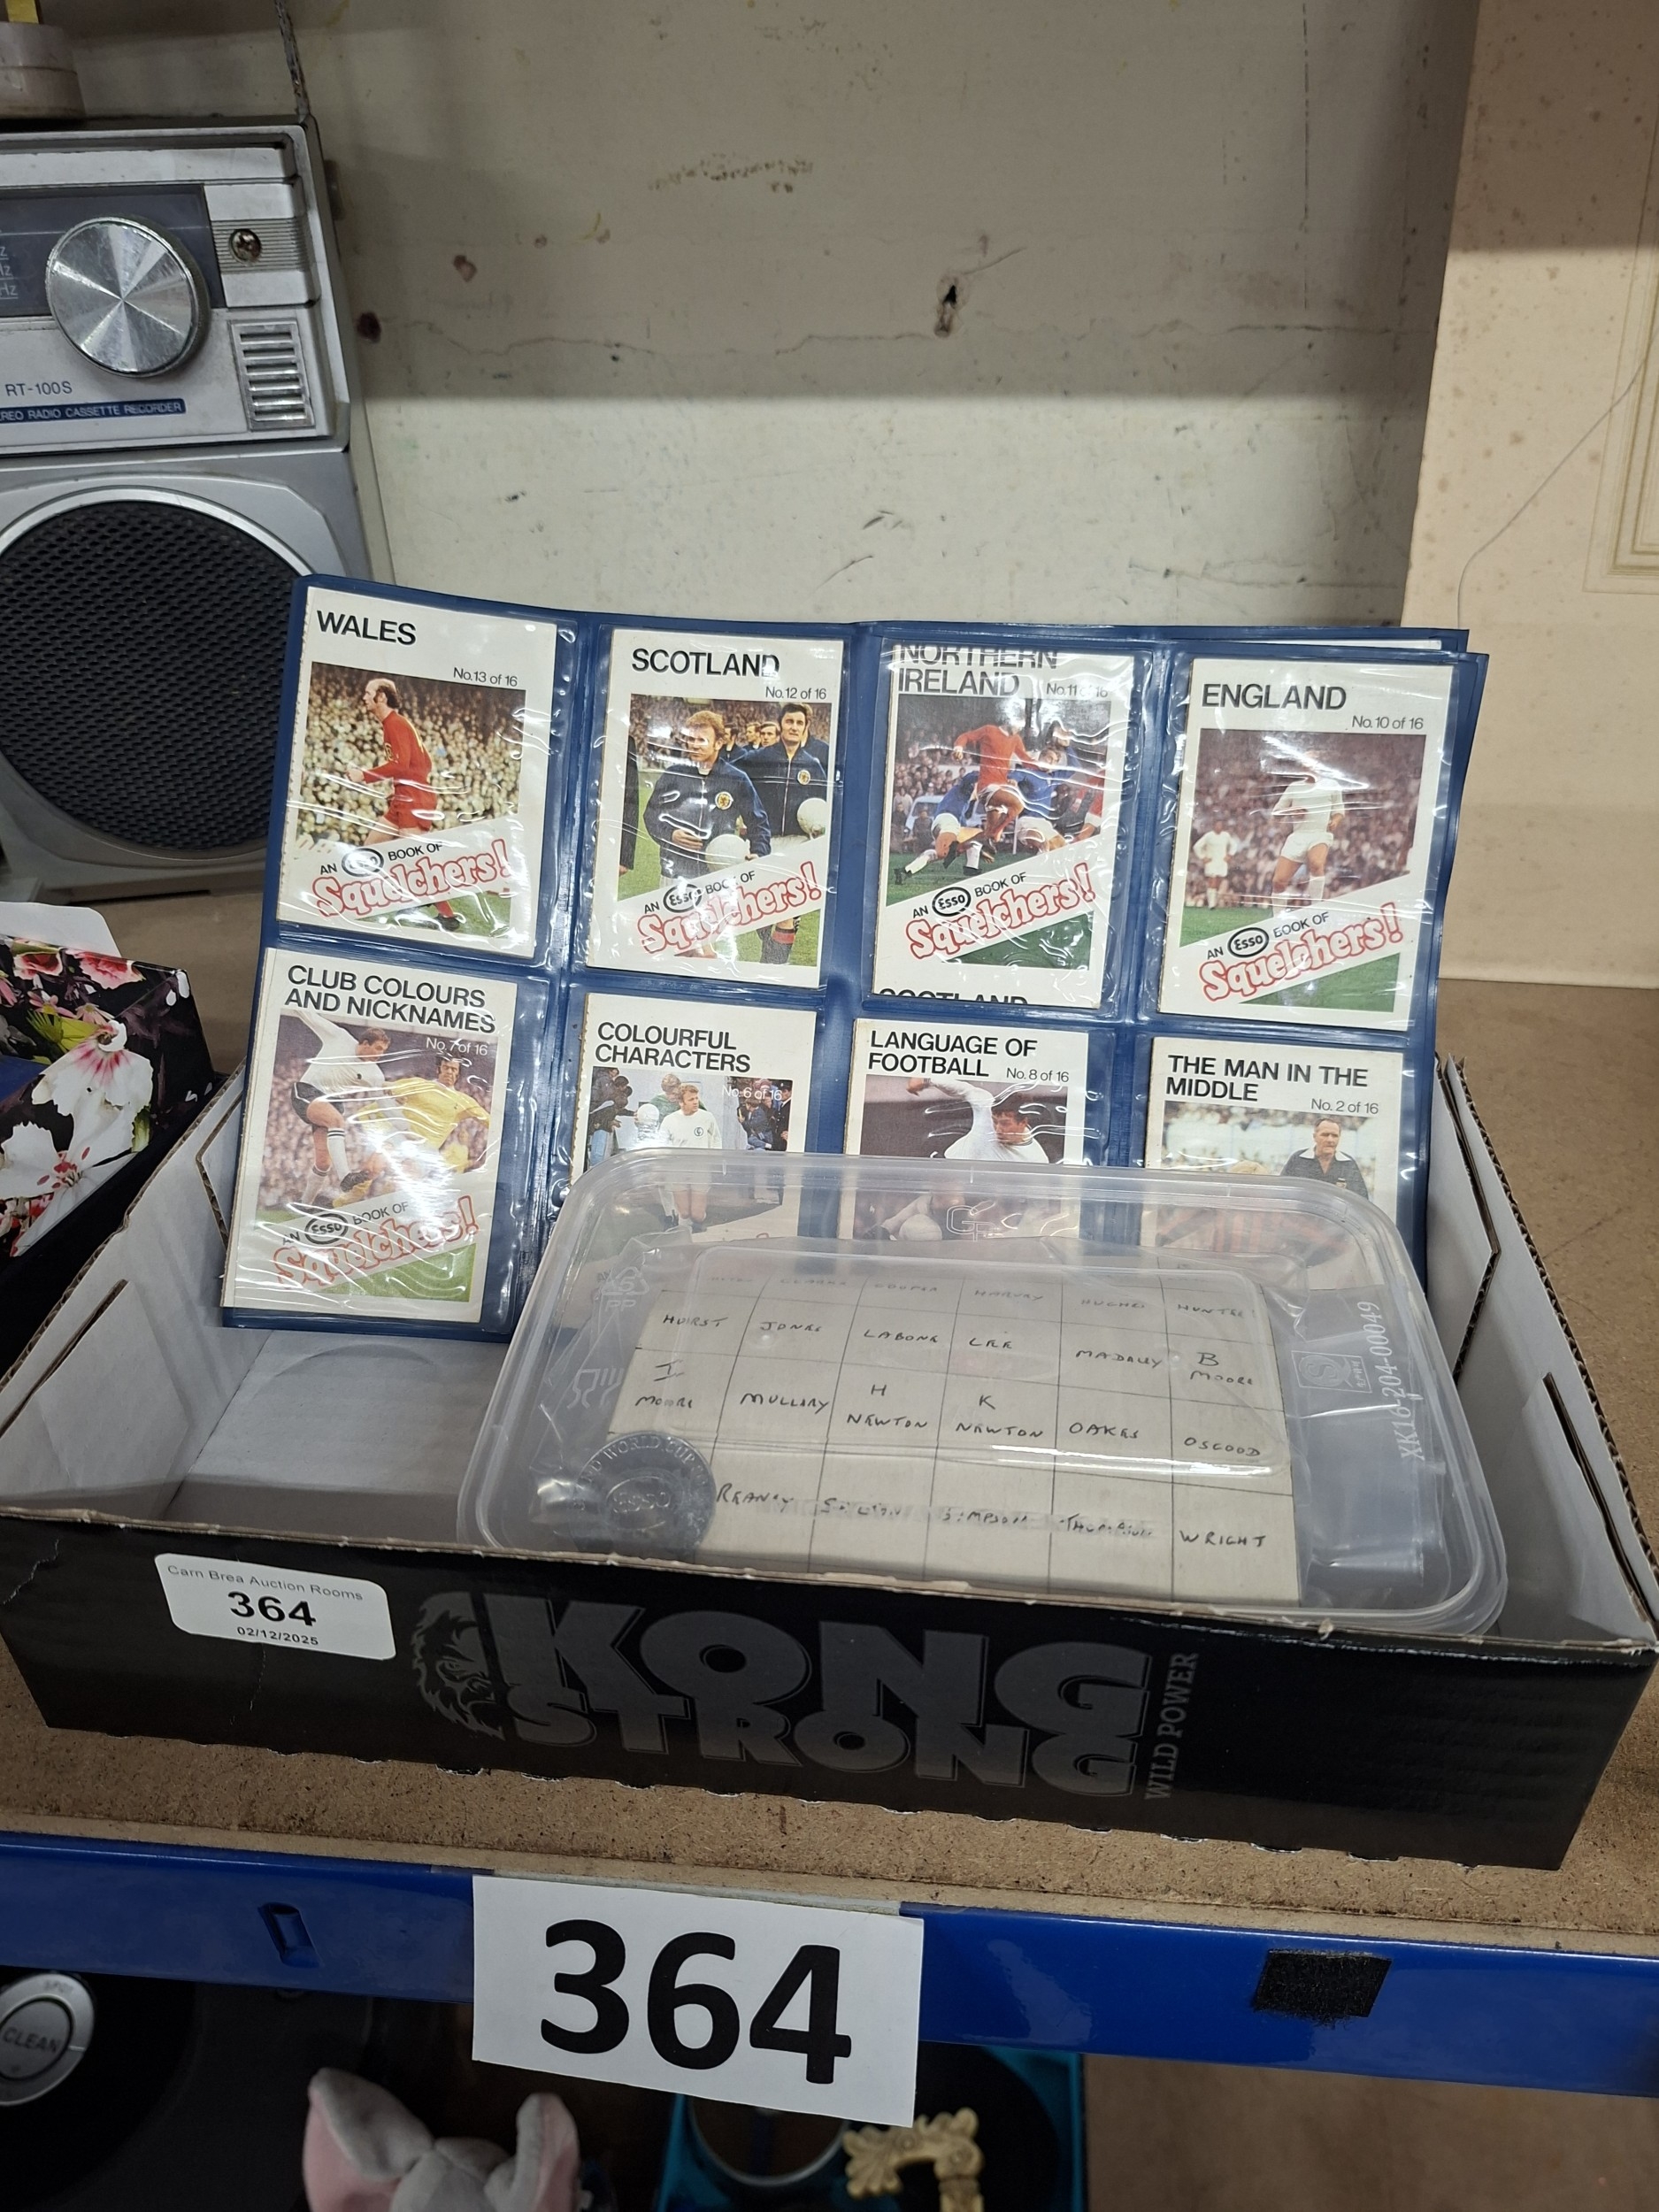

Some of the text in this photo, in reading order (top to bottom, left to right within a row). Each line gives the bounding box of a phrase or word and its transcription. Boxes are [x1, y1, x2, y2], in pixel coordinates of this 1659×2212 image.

[5, 380, 73, 396] RT-100S
[28, 408, 62, 419] RADIO
[65, 404, 119, 418] CASSETTE
[124, 402, 182, 415] RECORDER
[317, 610, 417, 645] WALES
[632, 648, 780, 678] SCOTLAND
[489, 673, 503, 686] of
[504, 675, 518, 687] 16
[800, 687, 811, 700] of
[814, 687, 827, 700] 16
[899, 668, 1019, 695] IRELAND
[1202, 683, 1347, 710] ENGLAND
[1392, 717, 1407, 729] of
[1409, 718, 1424, 730] 16
[319, 864, 338, 875] AN
[388, 845, 425, 861] BOOK
[644, 902, 660, 914] AN
[741, 871, 756, 883] OF
[913, 905, 929, 918] AN
[974, 879, 1009, 897] BOOK
[1011, 872, 1026, 883] OF
[906, 863, 1095, 959] Squelchers!
[1207, 947, 1224, 960] AN
[1273, 918, 1310, 938] BOOK
[1312, 912, 1329, 926] OF
[1200, 902, 1403, 1002] Squelchers!
[288, 964, 486, 1009] CLUB COLOURS
[284, 987, 495, 1033] AND NICKNAMES
[458, 1041, 472, 1054] of
[474, 1043, 488, 1056] 16
[598, 1021, 737, 1050] COLOURFUL
[871, 1030, 1038, 1056] LANGUAGE OF
[595, 1043, 750, 1073] CHARACTERS
[868, 1053, 989, 1077] FOOTBALL
[1168, 1054, 1369, 1087] THE MAN IN THE
[1006, 1067, 1069, 1082] No. 8 of 16
[743, 1087, 751, 1098] 6
[755, 1087, 770, 1100] of
[771, 1089, 782, 1101] 16
[1165, 1077, 1259, 1102] MIDDLE
[1311, 1098, 1379, 1115] No. 2 of 16
[352, 1209, 389, 1225] BOOK
[392, 1202, 409, 1213] OF
[1197, 1352, 1219, 1367] B
[871, 1384, 996, 1410] H K
[1069, 1422, 1139, 1440] OAKES
[1179, 1530, 1266, 1548] WRIGHT
[210, 1570, 244, 1585] Brea
[250, 1576, 304, 1594] Auction
[311, 1584, 364, 1601] Rooms
[227, 1590, 317, 1627] 364
[236, 1626, 319, 1646] 02/12/2025
[483, 1594, 1153, 1736] KONG
[1144, 1652, 1200, 1800] WILD POWER
[507, 1684, 1138, 1798] STRONG
[541, 1918, 852, 2085] 364
[3, 2026, 62, 2054] CLEAN
